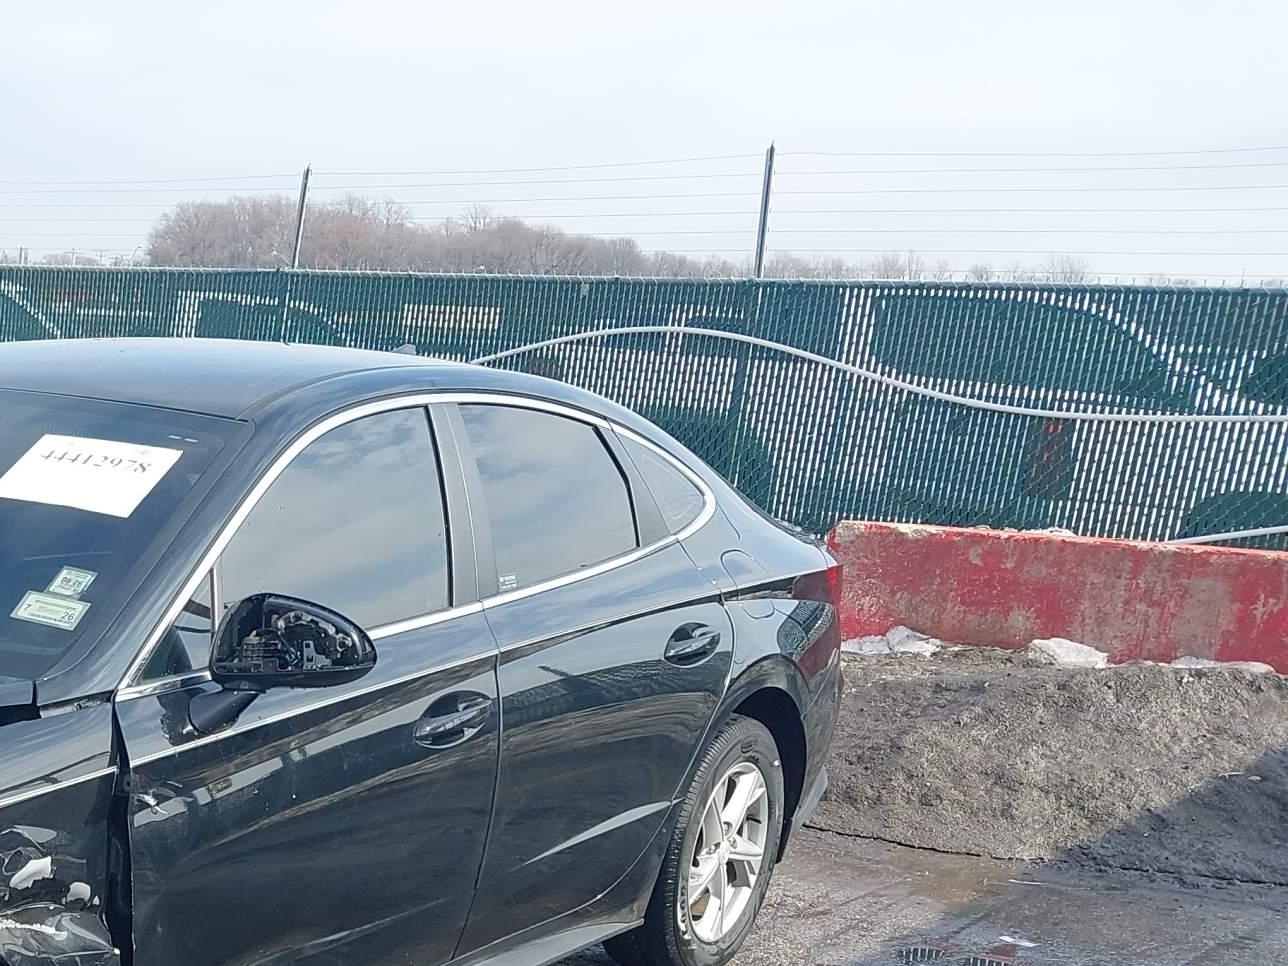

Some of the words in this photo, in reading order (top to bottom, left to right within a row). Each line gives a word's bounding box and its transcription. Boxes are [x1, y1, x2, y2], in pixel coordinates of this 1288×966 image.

[40, 450, 152, 473] 44412978
[23, 603, 32, 611] 7
[60, 611, 75, 621] 26
